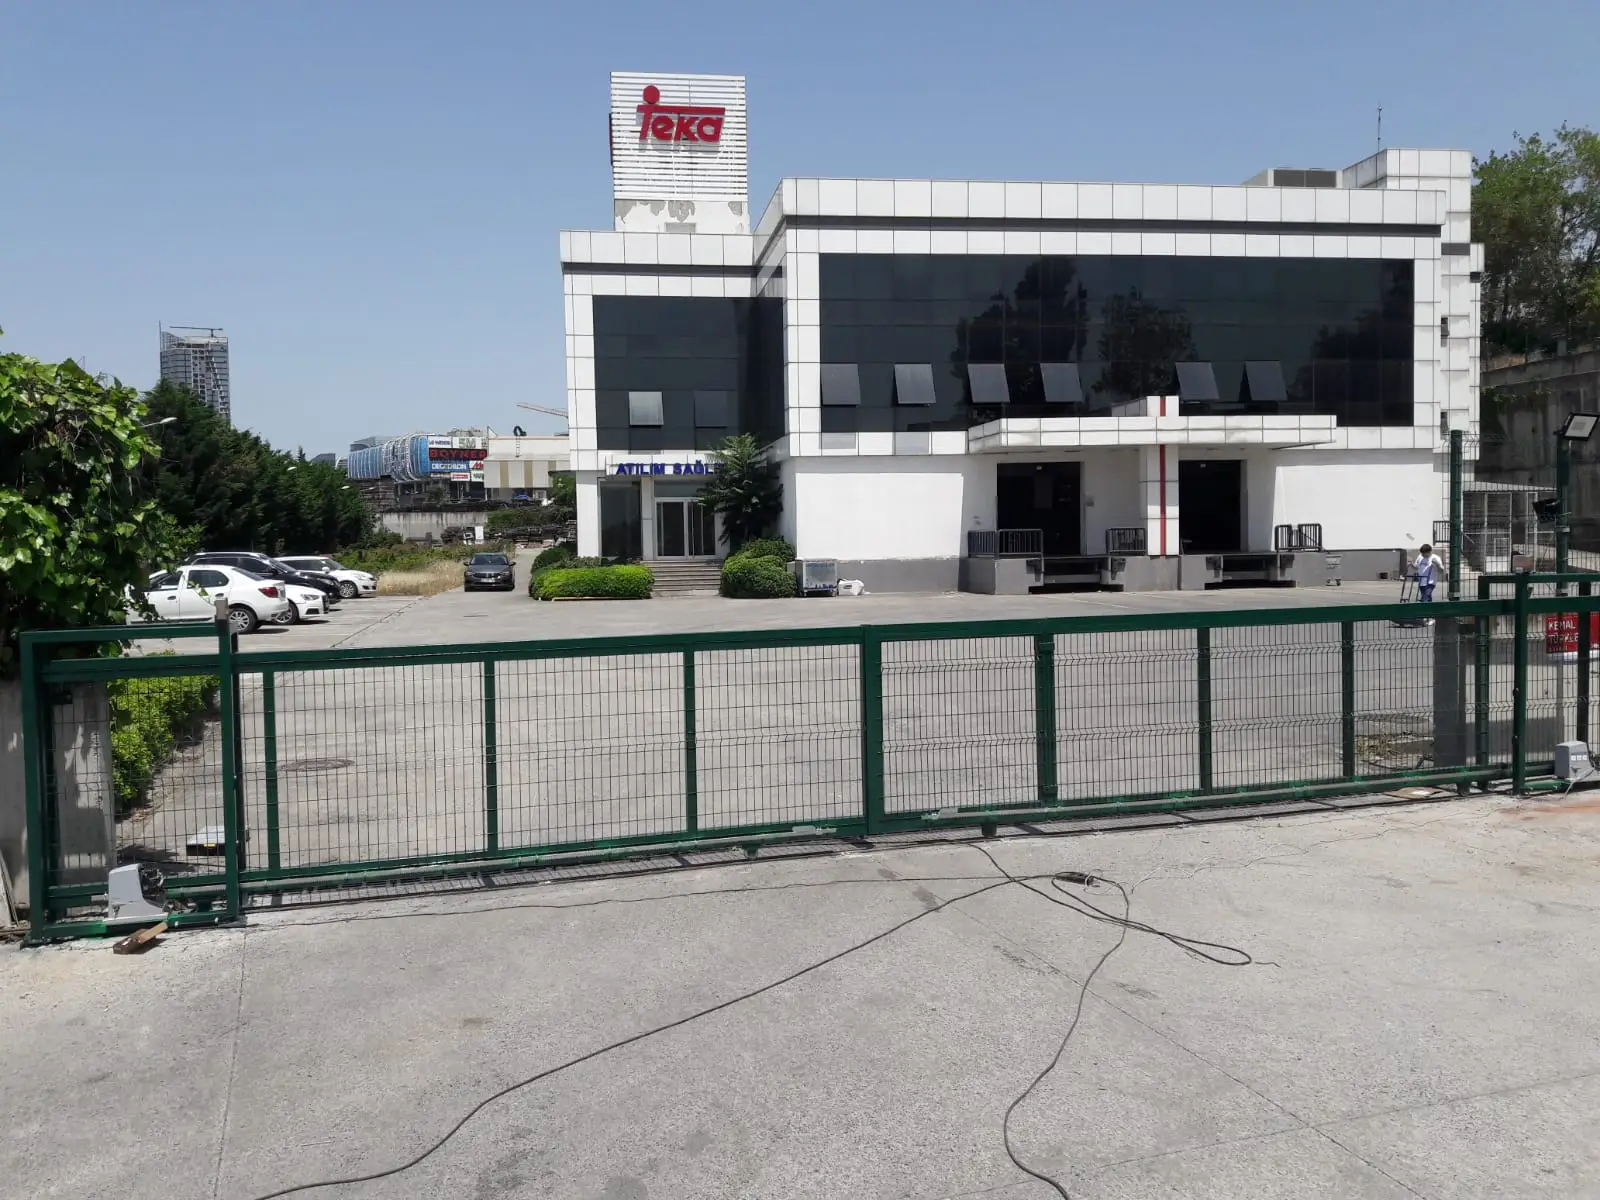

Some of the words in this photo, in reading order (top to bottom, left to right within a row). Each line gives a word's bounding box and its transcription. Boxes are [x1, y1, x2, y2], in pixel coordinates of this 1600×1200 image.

[615, 462, 666, 475] ATILIM
[672, 459, 725, 475] SAĞL
[1548, 620, 1576, 630] KEMAL
[1547, 632, 1579, 643] TÜRKLE
